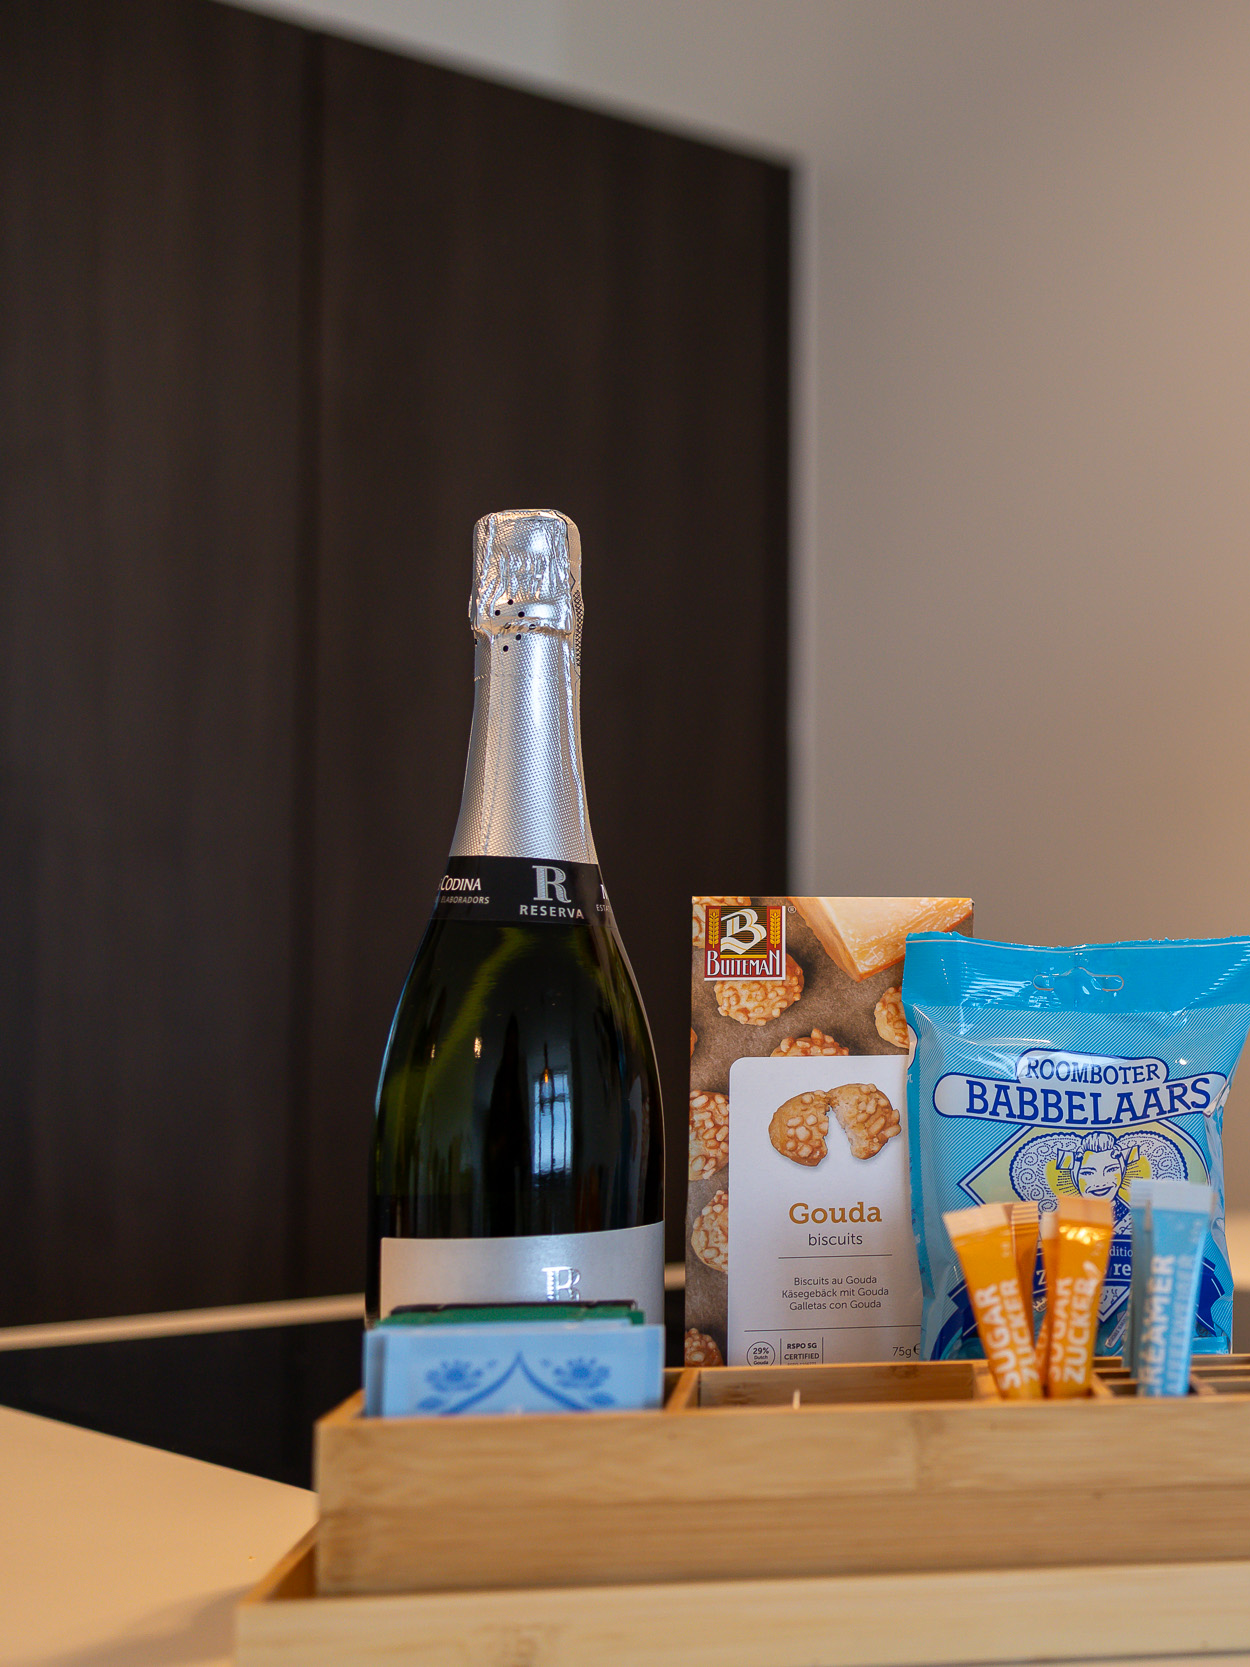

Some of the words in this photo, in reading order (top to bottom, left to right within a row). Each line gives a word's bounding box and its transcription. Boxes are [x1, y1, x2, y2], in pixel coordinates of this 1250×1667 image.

[440, 875, 482, 891] CODINA
[532, 865, 572, 903] R
[519, 905, 584, 919] RESERVA
[1026, 1058, 1160, 1086] ROOMBOTER
[966, 1077, 1212, 1125] BABBELAARS
[789, 1201, 882, 1224] Gouda
[808, 1232, 863, 1246] biscuits
[794, 1277, 829, 1286] Biscuits
[831, 1277, 843, 1285] au
[846, 1275, 877, 1285] Gouda
[781, 1288, 837, 1300] Käsegebäck
[840, 1288, 855, 1297] mit
[857, 1287, 889, 1296] Gouda
[789, 1301, 827, 1311] Galletas
[829, 1302, 848, 1310] con
[850, 1299, 882, 1309] Gouda
[974, 1283, 1021, 1390] SUGAR
[1000, 1278, 1040, 1383] ZUCKER
[1064, 1276, 1099, 1384] ZUCKER
[752, 1347, 770, 1355] 29%
[784, 1352, 820, 1360] CERTIFIED
